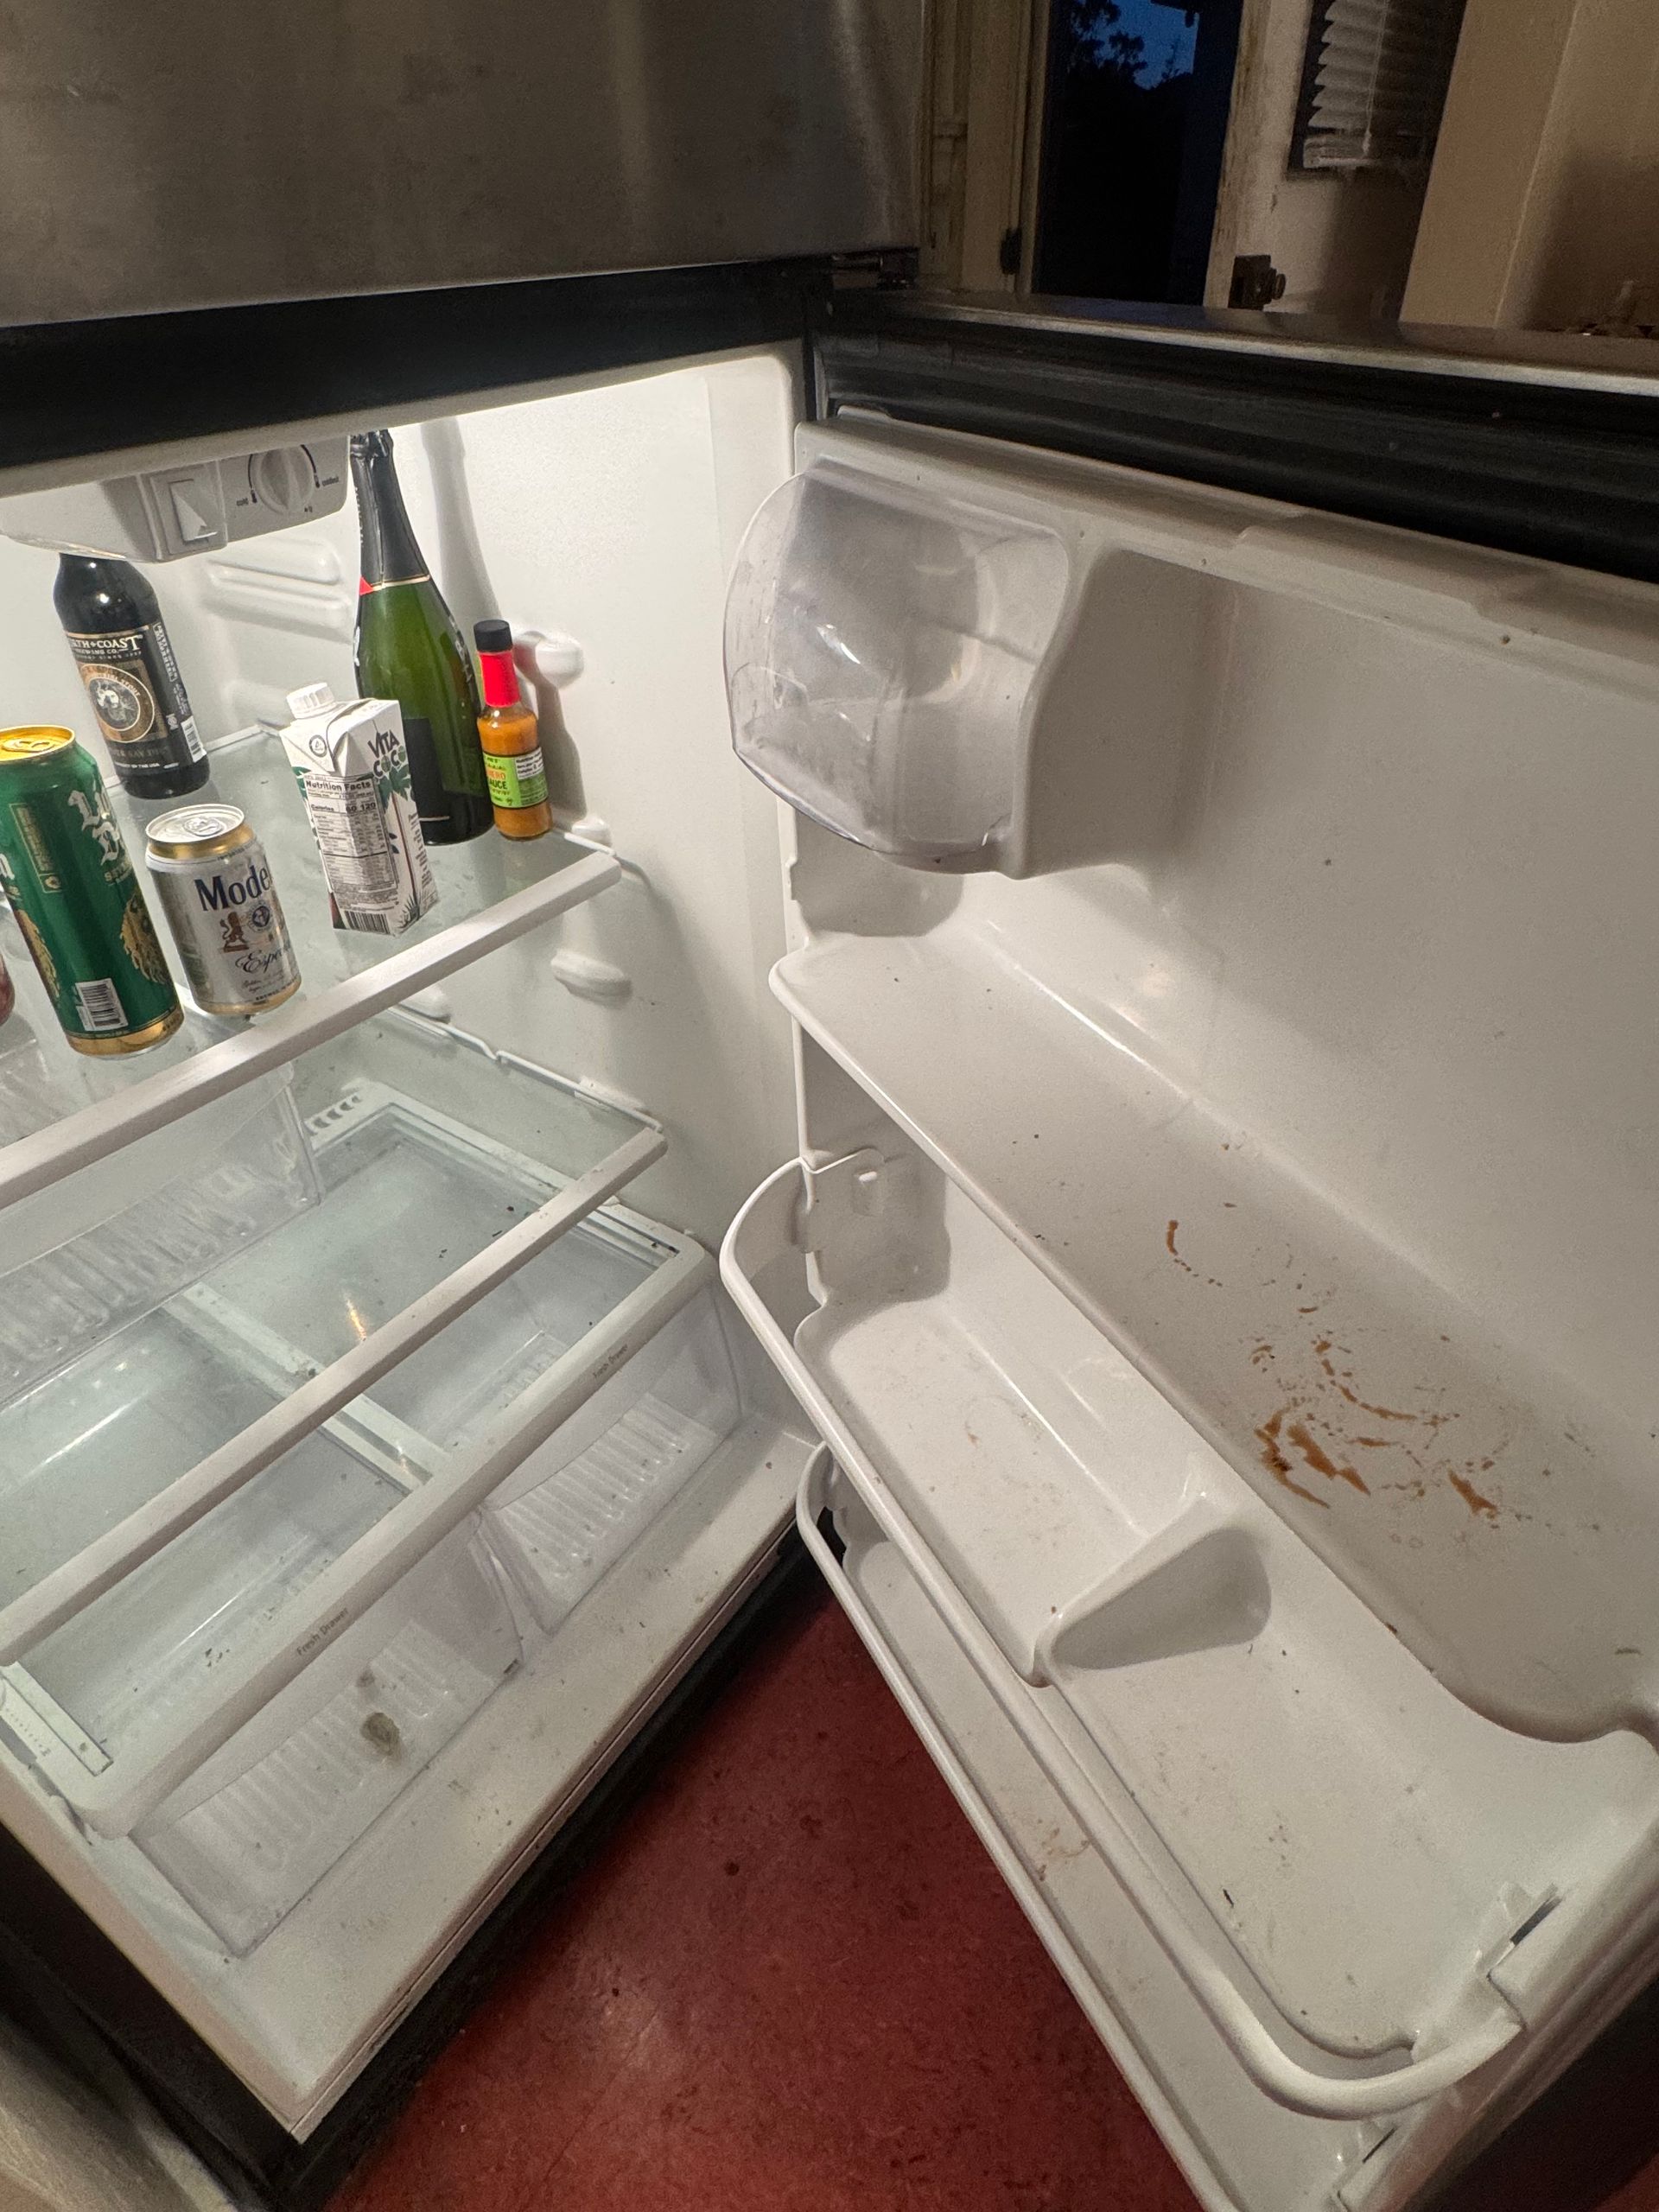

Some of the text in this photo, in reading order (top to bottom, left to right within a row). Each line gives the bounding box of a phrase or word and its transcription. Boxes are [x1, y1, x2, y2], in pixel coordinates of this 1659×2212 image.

[96, 635, 141, 651] COAST
[367, 729, 400, 759] VITA
[372, 745, 407, 778] COCO
[306, 780, 372, 791] Nutrition Facts
[489, 779, 508, 790] AUCE
[360, 802, 376, 811] 120
[296, 1607, 349, 1656] Fresh Drawer
